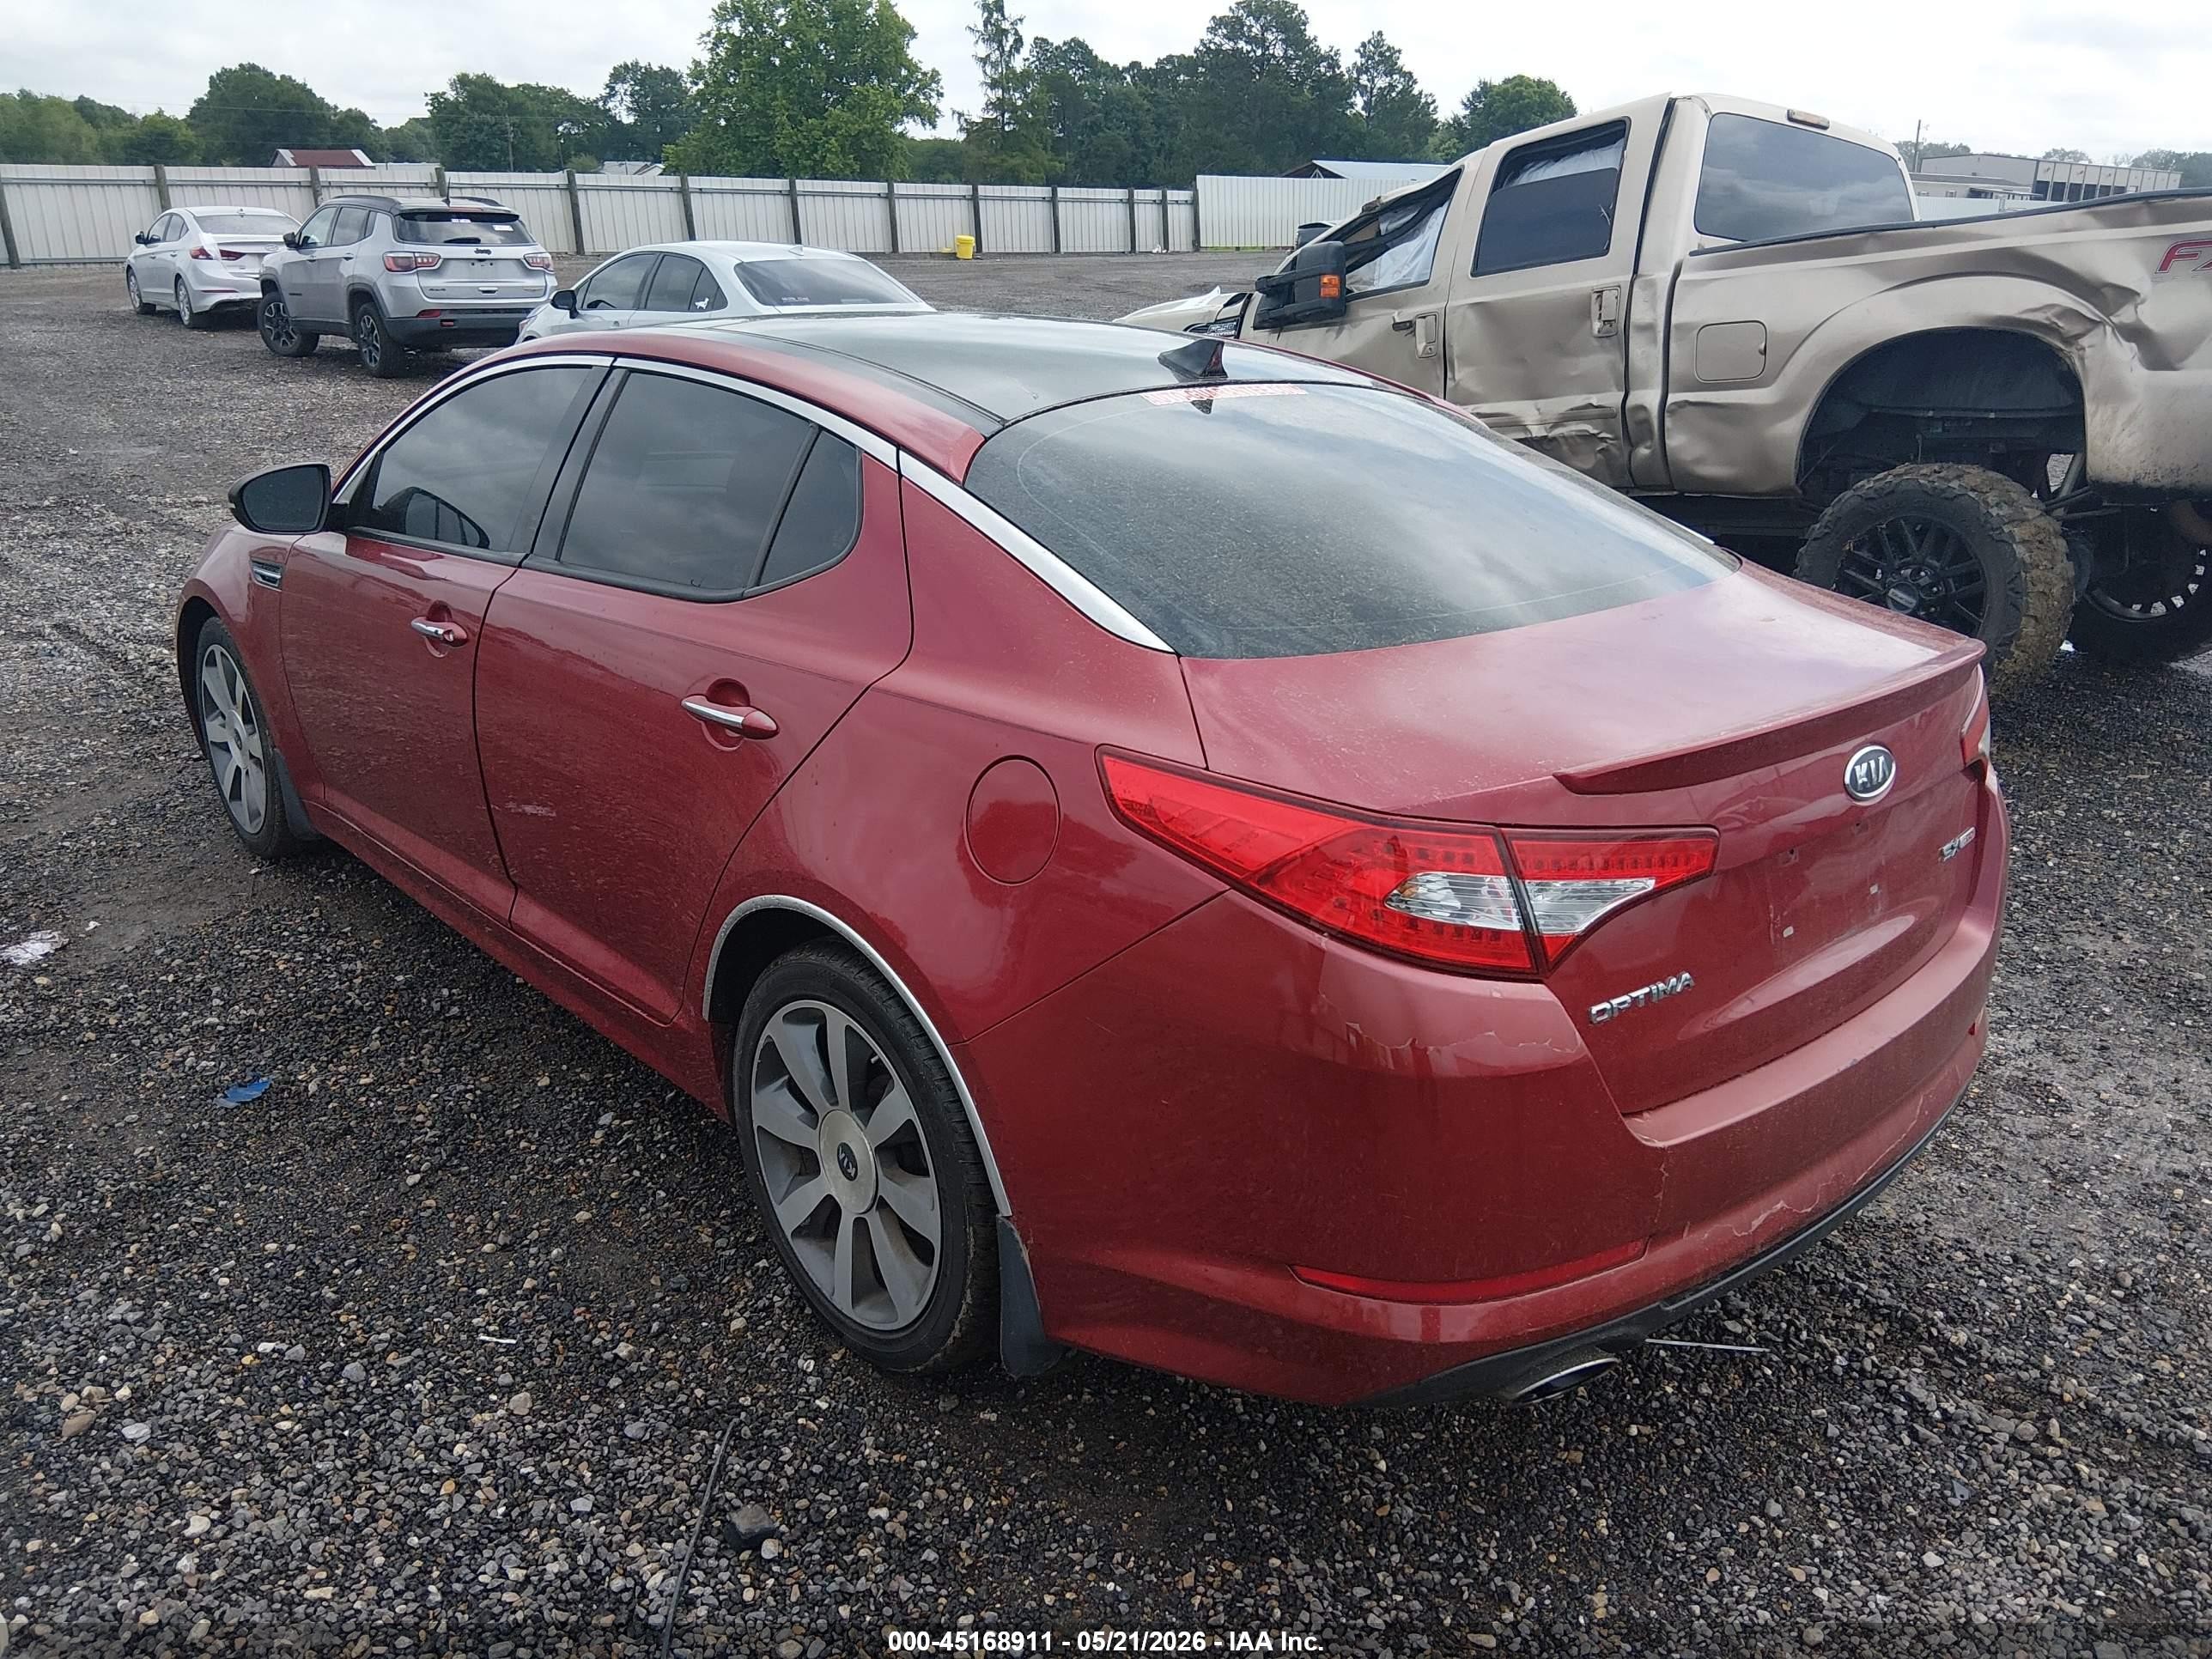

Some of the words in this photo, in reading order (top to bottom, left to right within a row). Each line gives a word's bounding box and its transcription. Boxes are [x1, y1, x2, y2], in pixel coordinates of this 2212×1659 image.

[2154, 240, 2212, 274] F
[1854, 755, 1890, 791] KIA
[1589, 970, 1694, 1024] OPTIMA
[838, 1145, 856, 1177] KIA
